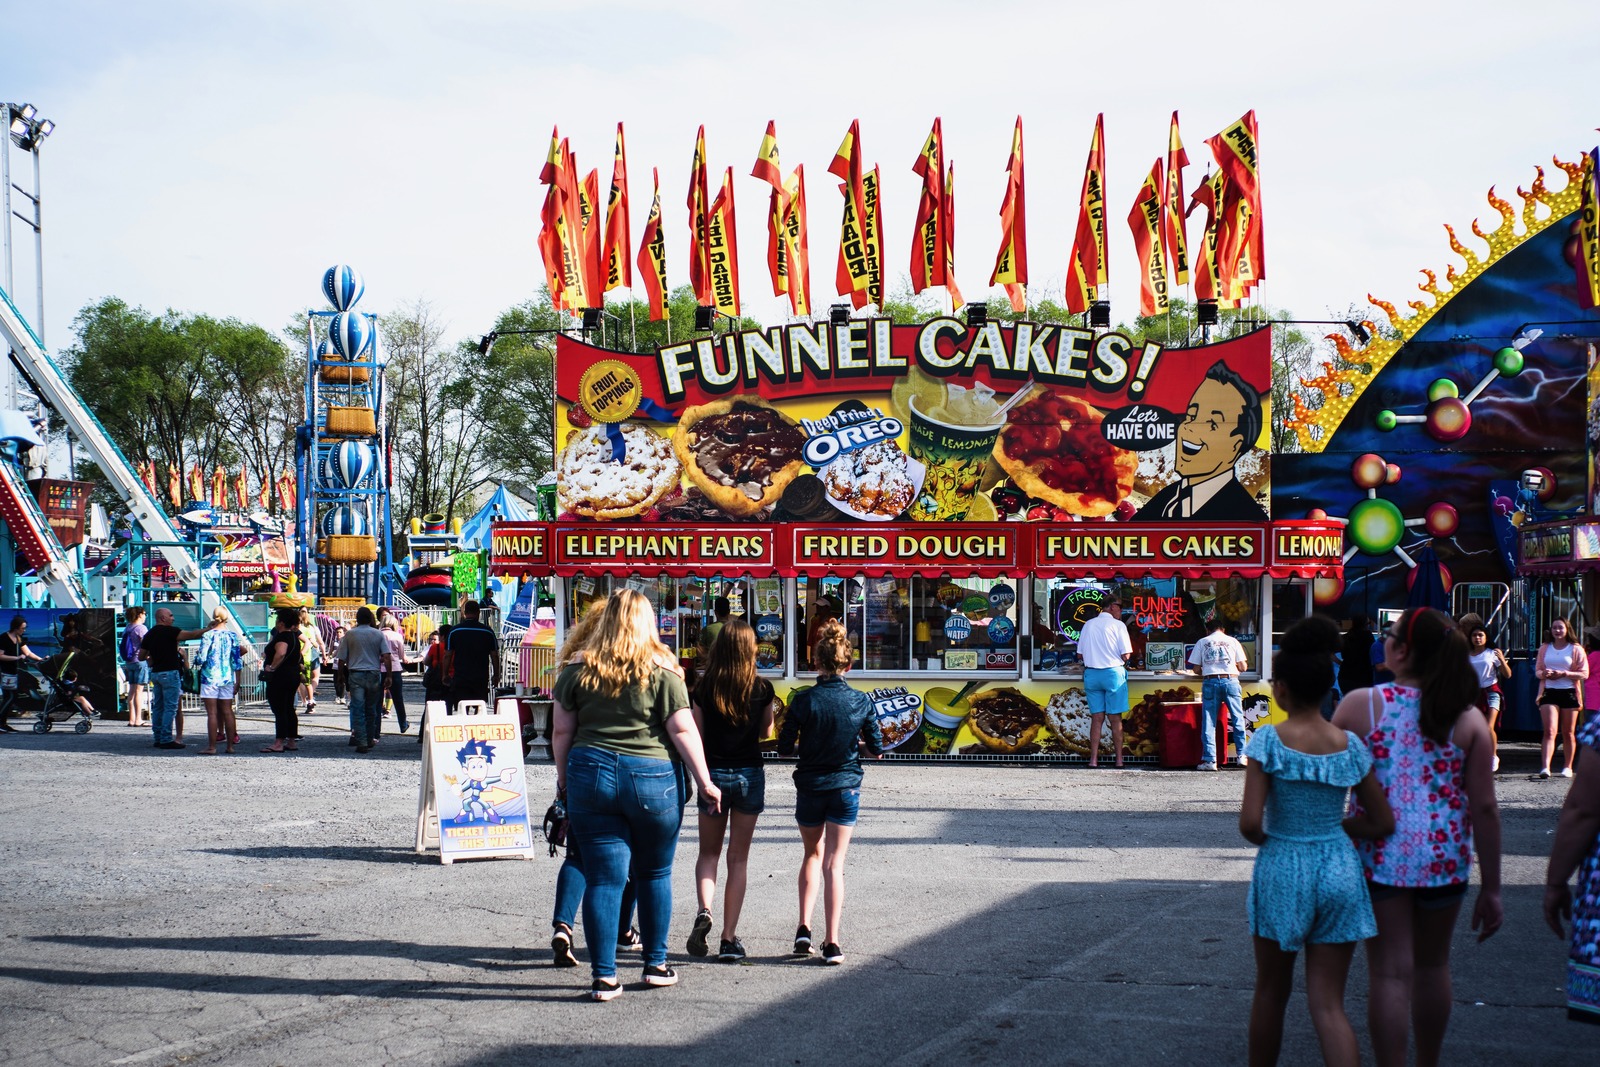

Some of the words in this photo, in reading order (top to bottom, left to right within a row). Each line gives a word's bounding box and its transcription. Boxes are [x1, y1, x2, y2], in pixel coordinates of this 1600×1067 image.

[657, 318, 908, 399] FUNNEL
[917, 317, 1162, 396] CAKES!
[591, 371, 618, 395] FRUIT
[591, 377, 634, 412] TOPPINGS
[1121, 405, 1160, 423] Lets
[800, 415, 839, 436] Deep
[1106, 423, 1143, 440] HAVE
[1146, 423, 1175, 440] ONE
[804, 418, 902, 464] OREO
[566, 535, 694, 557] ELEPHANT
[700, 536, 764, 558] EARS
[803, 536, 889, 557] FRIED
[897, 535, 1006, 557] DOUGH
[1046, 536, 1155, 557] FUNNEL
[1162, 535, 1254, 557] CAKES
[1279, 535, 1341, 557] LEMONA
[240, 565, 264, 573] OREOS
[989, 592, 1015, 603] OREO
[1133, 596, 1188, 612] FUNNEL
[757, 623, 781, 632] OREO
[945, 618, 970, 630] BOTTLED
[1136, 612, 1183, 628] CAKES
[946, 629, 969, 640] WATER
[987, 654, 1015, 664] OREO
[875, 694, 921, 715] REO
[434, 725, 463, 742] RIDE
[464, 724, 515, 742] TICKETS
[445, 826, 485, 838] TICKET
[487, 824, 524, 836] BOXES
[458, 838, 485, 849] THIS
[487, 836, 515, 848] WAY
